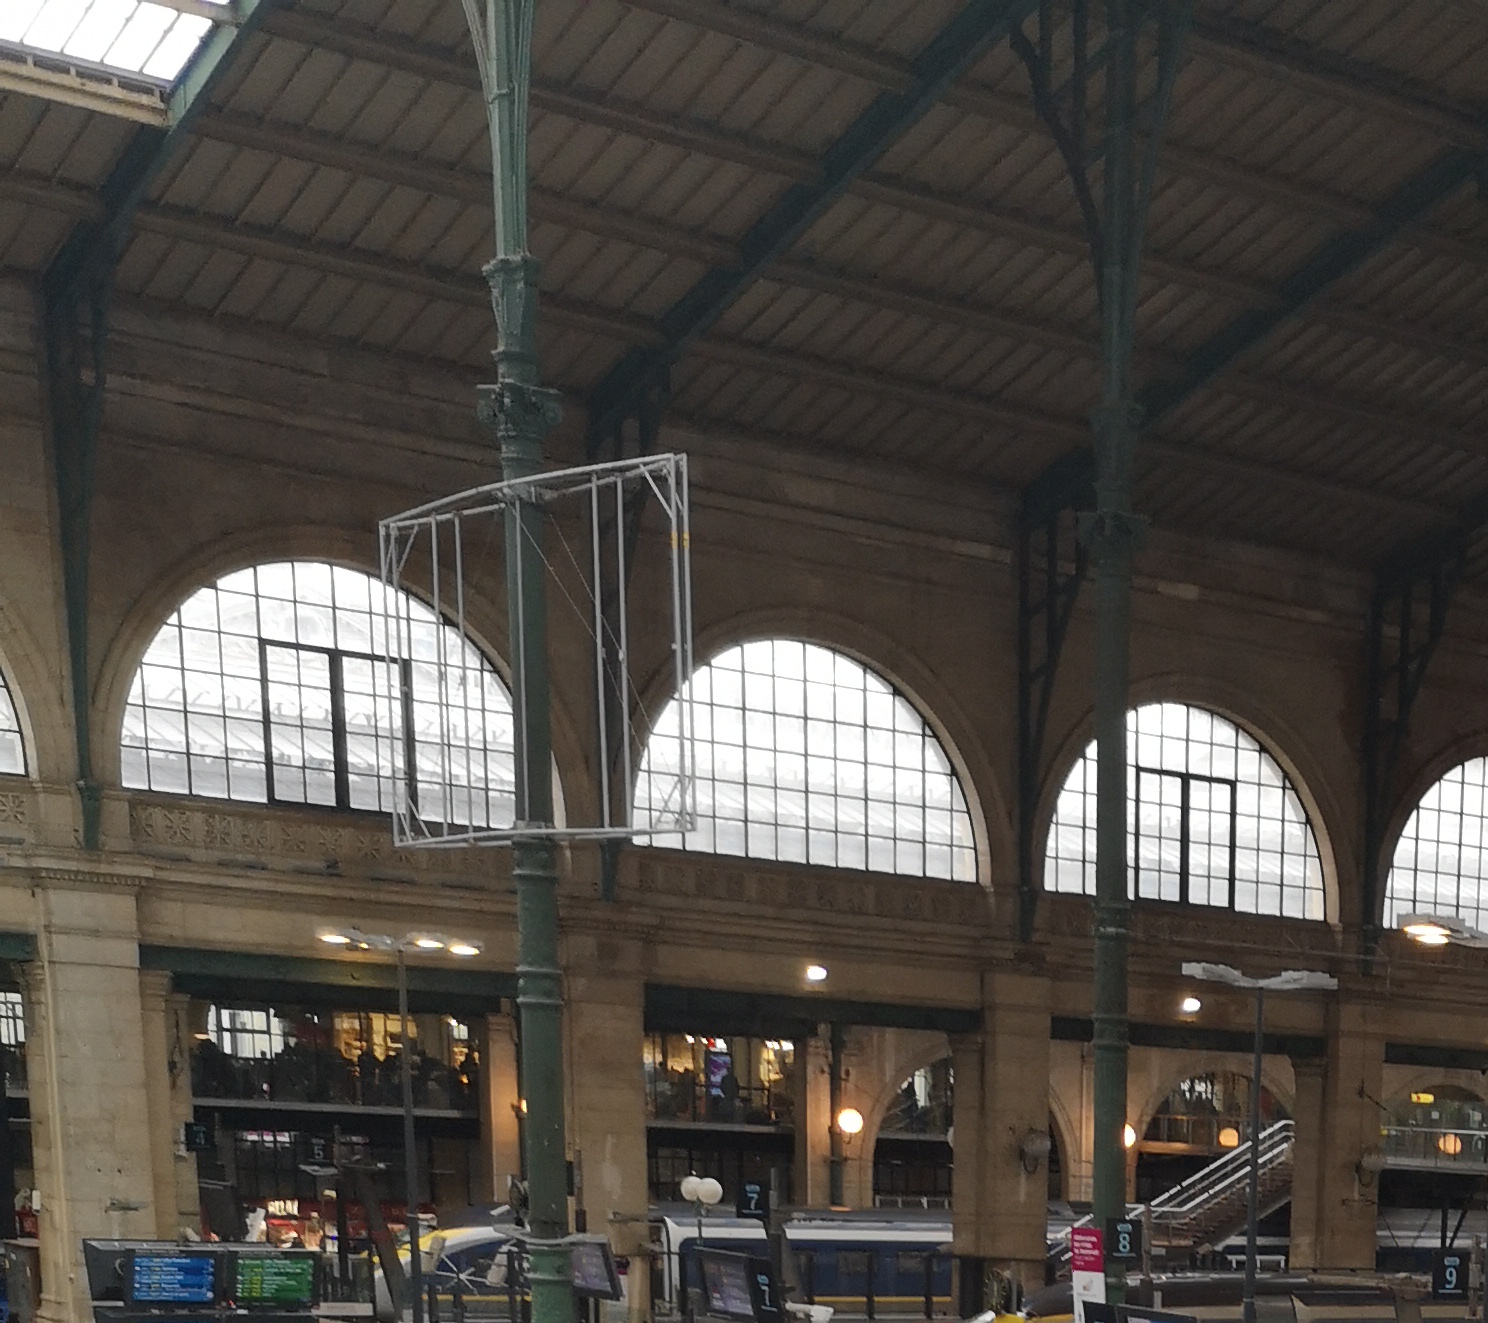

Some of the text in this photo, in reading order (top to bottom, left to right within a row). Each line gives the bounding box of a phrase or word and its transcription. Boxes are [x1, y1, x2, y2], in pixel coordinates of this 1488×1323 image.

[314, 1143, 324, 1159] 5
[747, 1192, 760, 1211] 7
[1118, 1232, 1131, 1253] 8
[1444, 1267, 1457, 1289] 9
